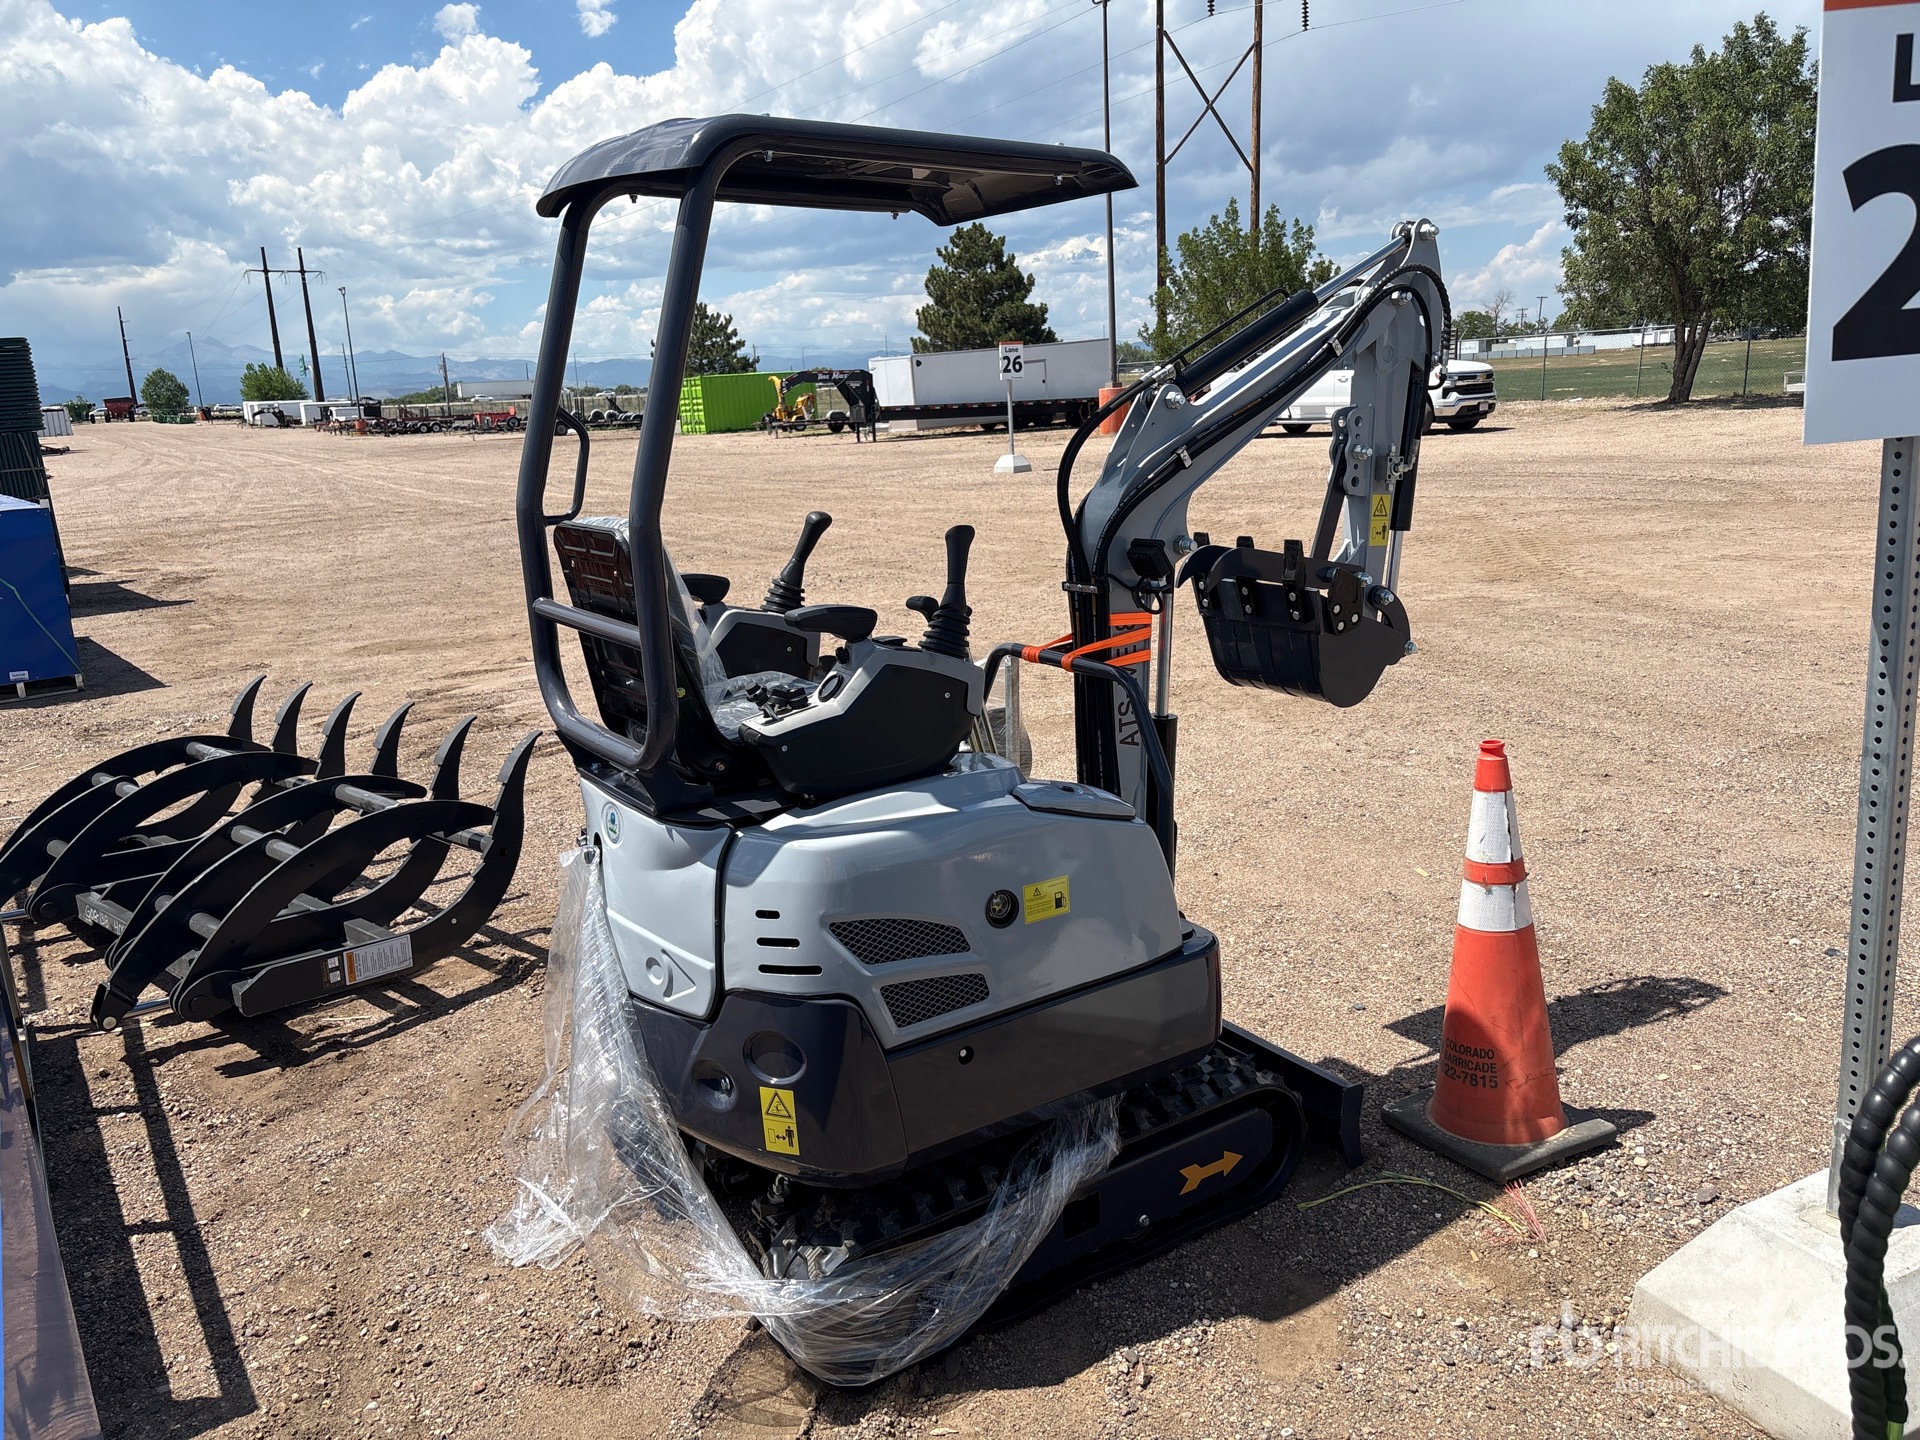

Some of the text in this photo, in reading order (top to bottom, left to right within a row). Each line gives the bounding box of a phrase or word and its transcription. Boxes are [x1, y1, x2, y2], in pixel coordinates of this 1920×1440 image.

[1832, 143, 1920, 361] 2
[1002, 355, 1023, 374] 26
[1445, 1038, 1495, 1060] COLORADO
